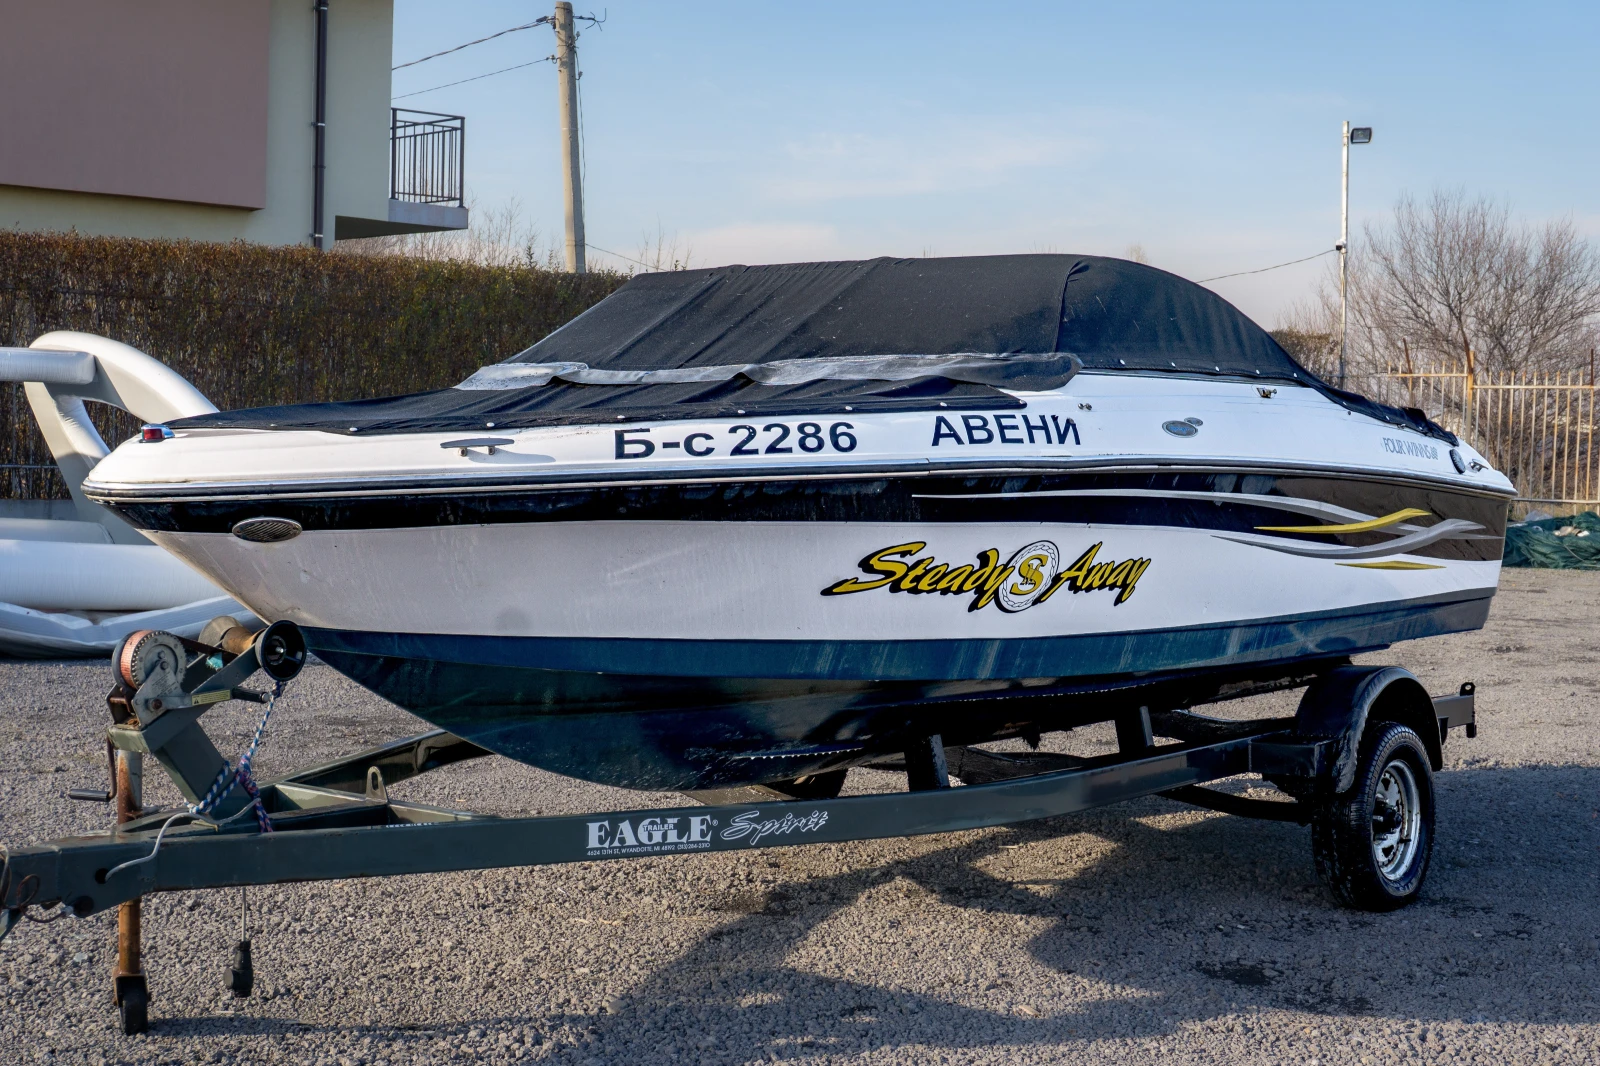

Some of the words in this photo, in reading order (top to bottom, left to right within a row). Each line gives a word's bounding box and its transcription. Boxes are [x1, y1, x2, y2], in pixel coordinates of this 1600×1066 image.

[729, 421, 858, 456] 2286
[931, 414, 1081, 447] АВЕНИ
[1382, 437, 1406, 455] FOUR
[1403, 440, 1431, 460] WINNS
[821, 541, 1014, 612] Steady
[1032, 541, 1152, 606] Away
[586, 815, 712, 848] EAGLE
[720, 810, 828, 845] Spirit
[643, 823, 674, 832] TRAILER
